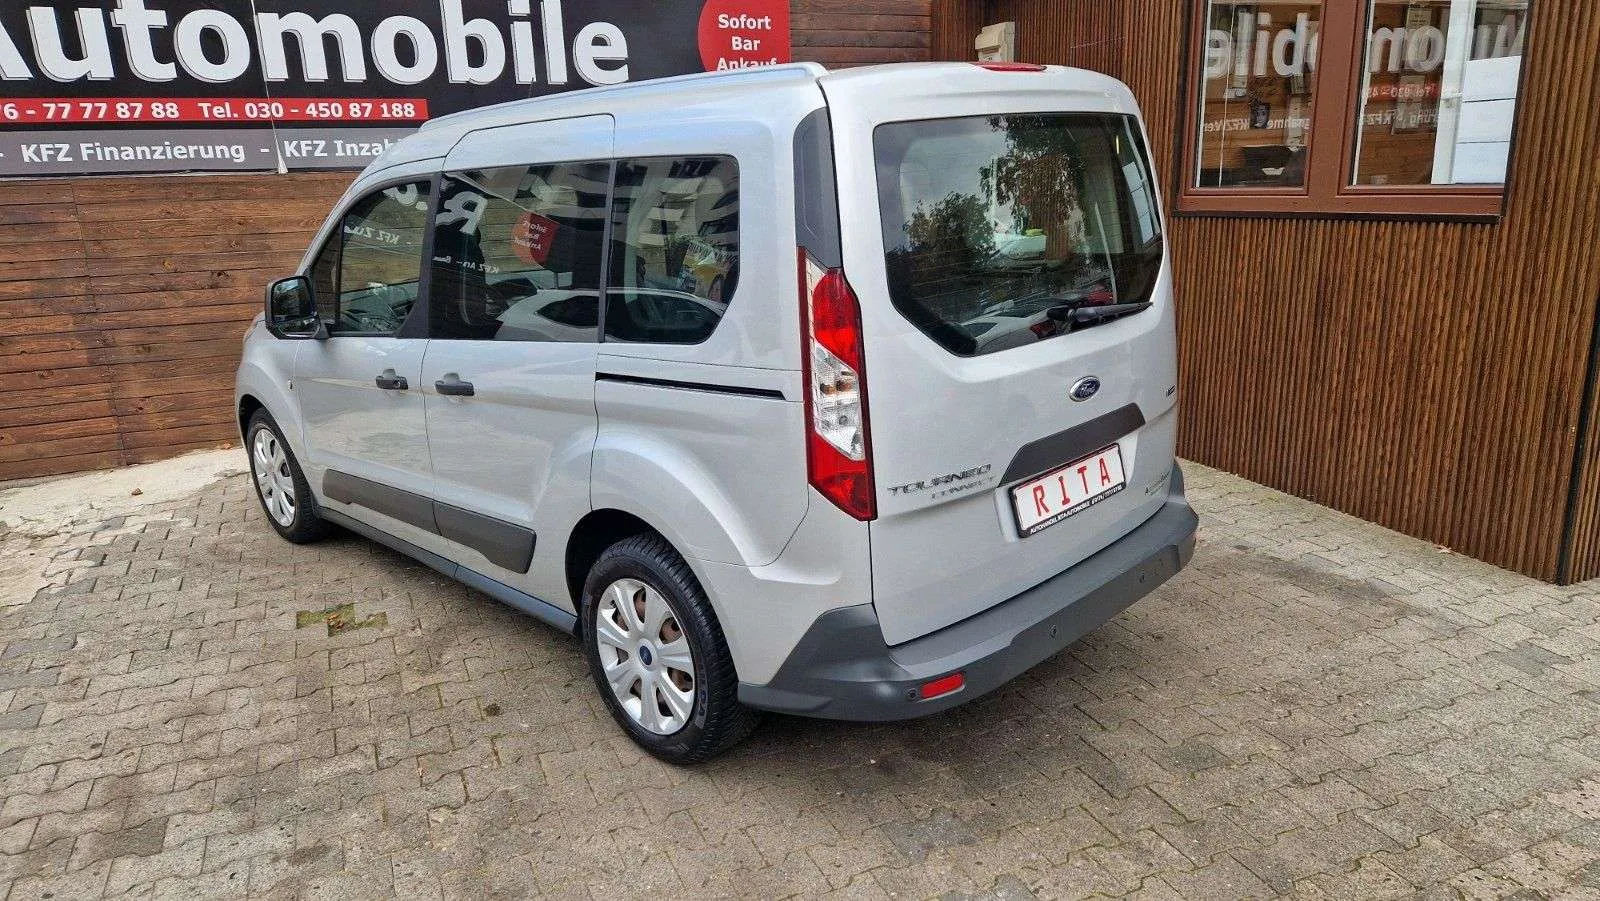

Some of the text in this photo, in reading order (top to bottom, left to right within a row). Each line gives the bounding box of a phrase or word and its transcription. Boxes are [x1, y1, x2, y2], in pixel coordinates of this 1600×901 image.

[718, 13, 772, 30] Sofort
[731, 35, 761, 51] Bar
[0, 102, 19, 120] 6
[42, 102, 71, 119] 77
[79, 102, 107, 119] 77
[115, 102, 143, 119] 87
[151, 102, 180, 119] 88
[198, 102, 238, 118] Tel.
[244, 102, 284, 118] 030
[305, 102, 342, 118] 450
[349, 102, 374, 118] 87
[379, 102, 415, 118] 188
[20, 143, 73, 163] KFZ
[79, 141, 246, 163] Finanzierung
[283, 140, 328, 158] KFZ
[1032, 457, 1111, 517] RITA
